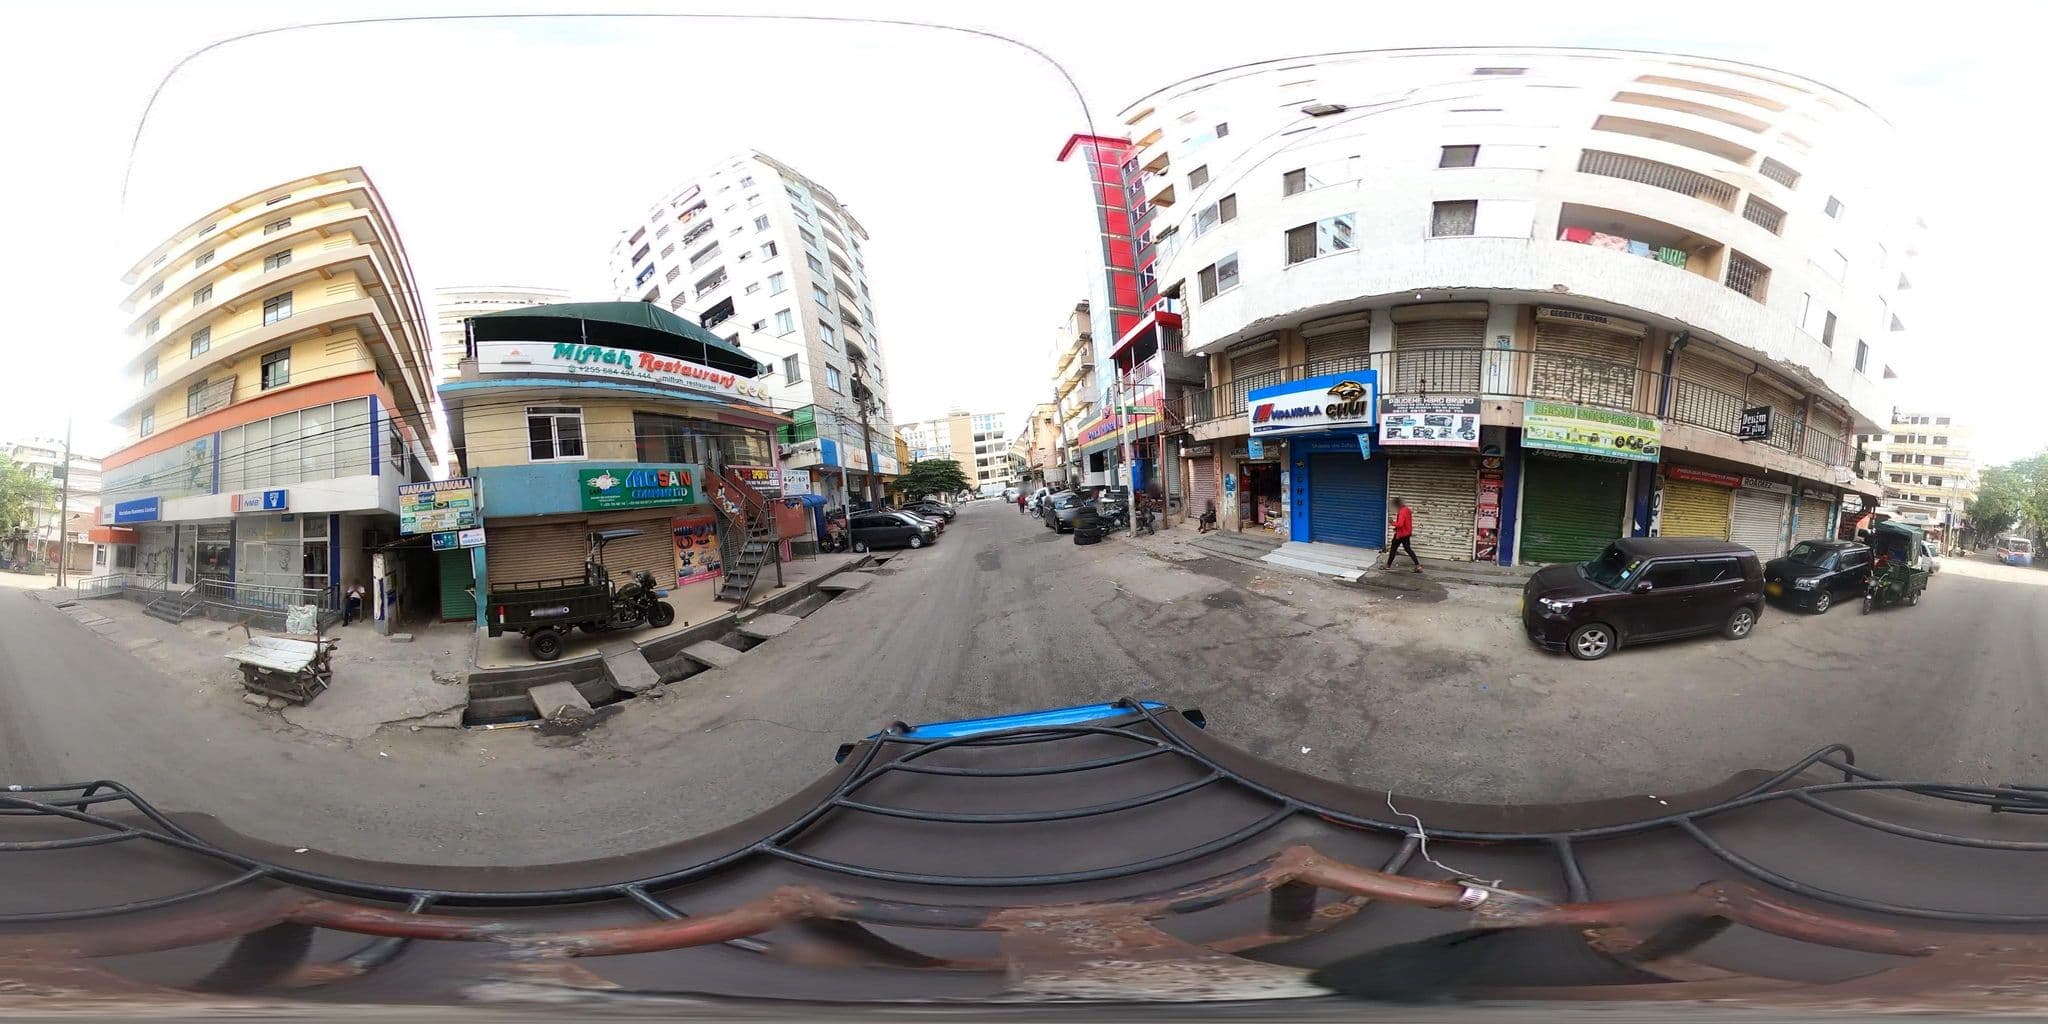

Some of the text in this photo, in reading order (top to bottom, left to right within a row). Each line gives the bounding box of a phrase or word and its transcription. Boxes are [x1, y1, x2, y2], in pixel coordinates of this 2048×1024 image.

[638, 351, 736, 388] Restaurant
[1326, 401, 1367, 420] CHUI
[400, 480, 471, 495] WAKALA WAKALA
[625, 470, 692, 488] MOSAN
